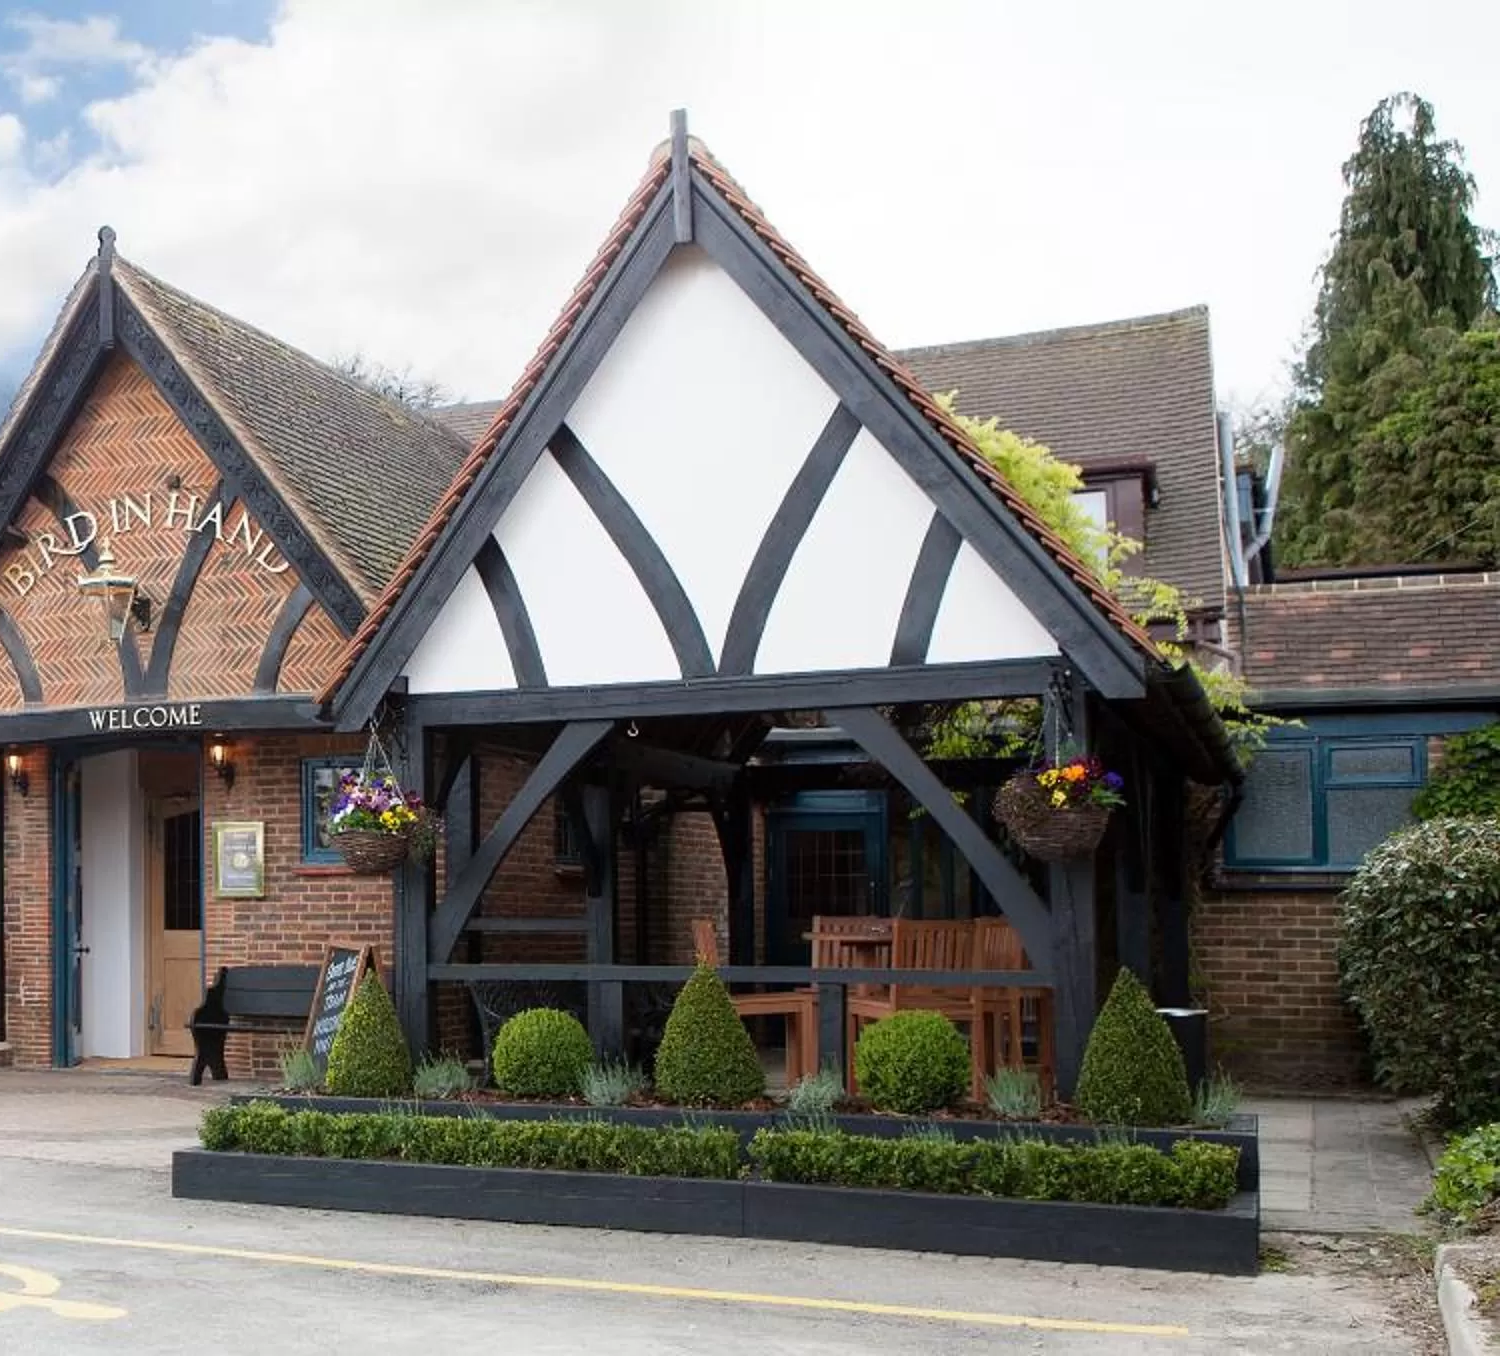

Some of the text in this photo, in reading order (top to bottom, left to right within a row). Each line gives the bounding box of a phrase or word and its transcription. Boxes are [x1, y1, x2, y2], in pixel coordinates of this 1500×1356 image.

[4, 493, 289, 597] BIRD IN HAND
[89, 704, 202, 730] WELCOME
